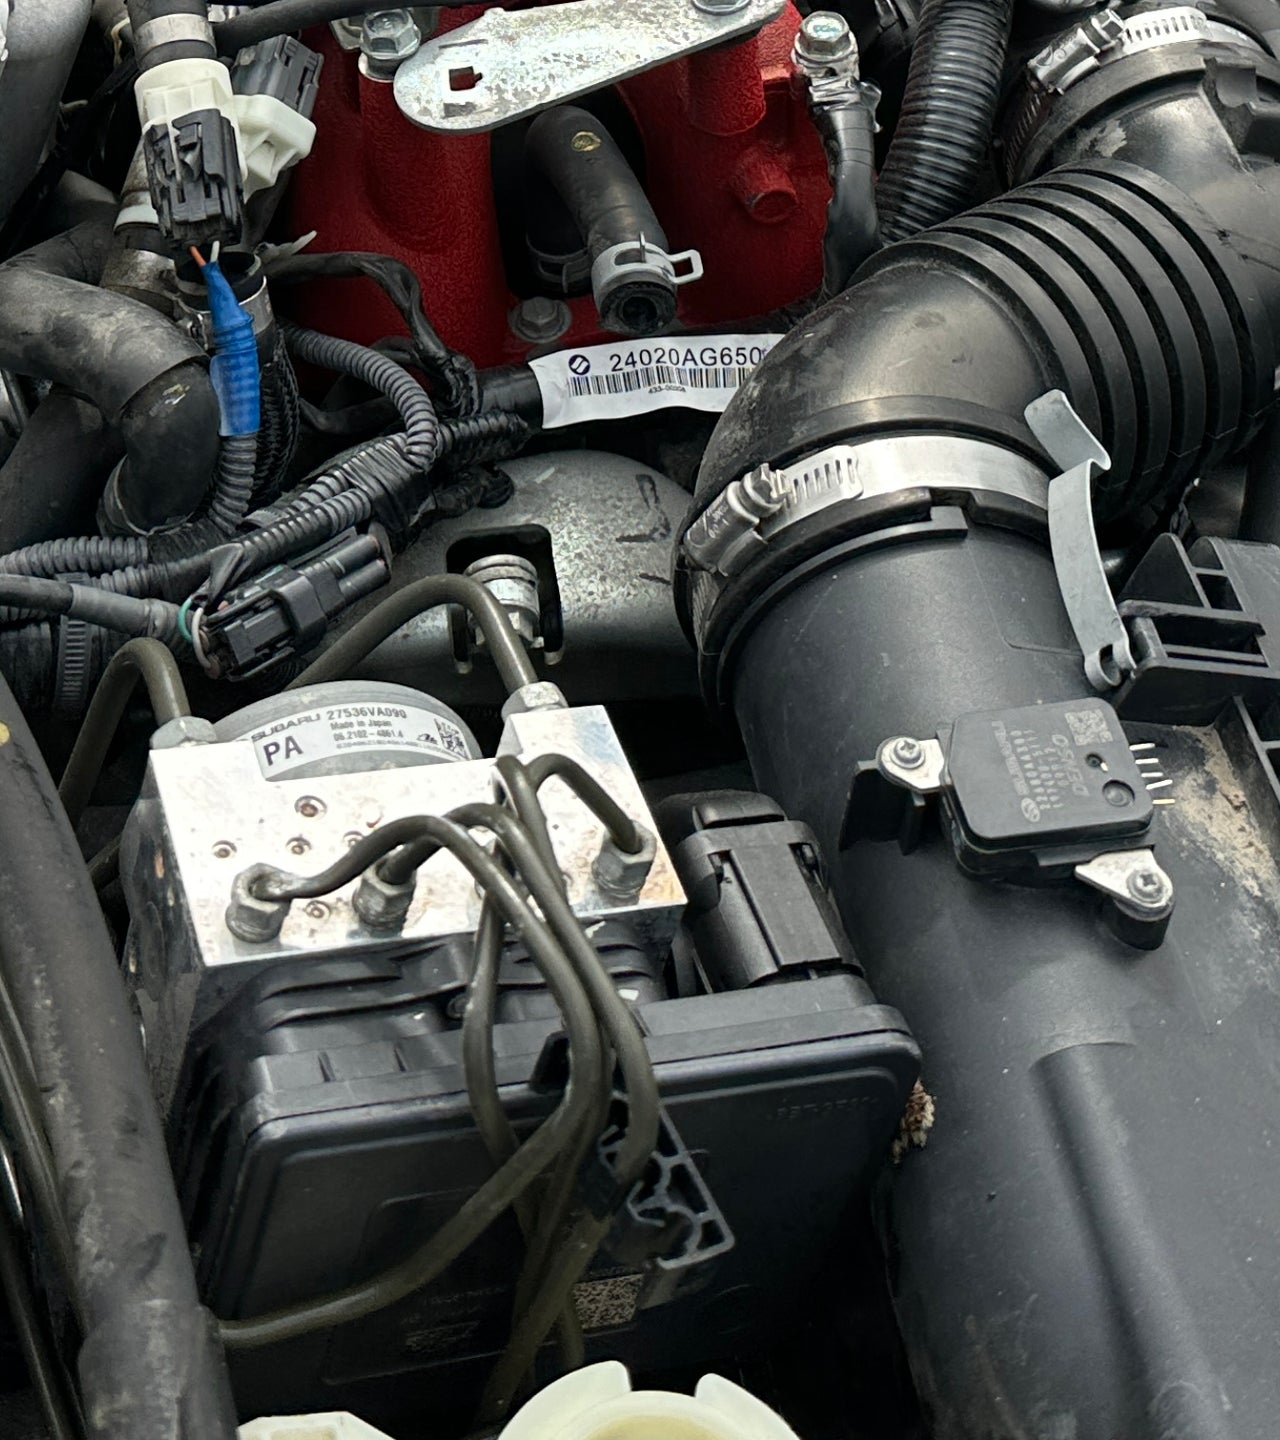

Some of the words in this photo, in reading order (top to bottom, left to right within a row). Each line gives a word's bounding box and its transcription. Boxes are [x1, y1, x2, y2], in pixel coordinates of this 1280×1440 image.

[251, 713, 321, 742] SUBARU
[330, 720, 354, 730] Made
[368, 719, 392, 727] Japan
[263, 735, 304, 766] PA
[1050, 734, 1089, 799] DENSO
